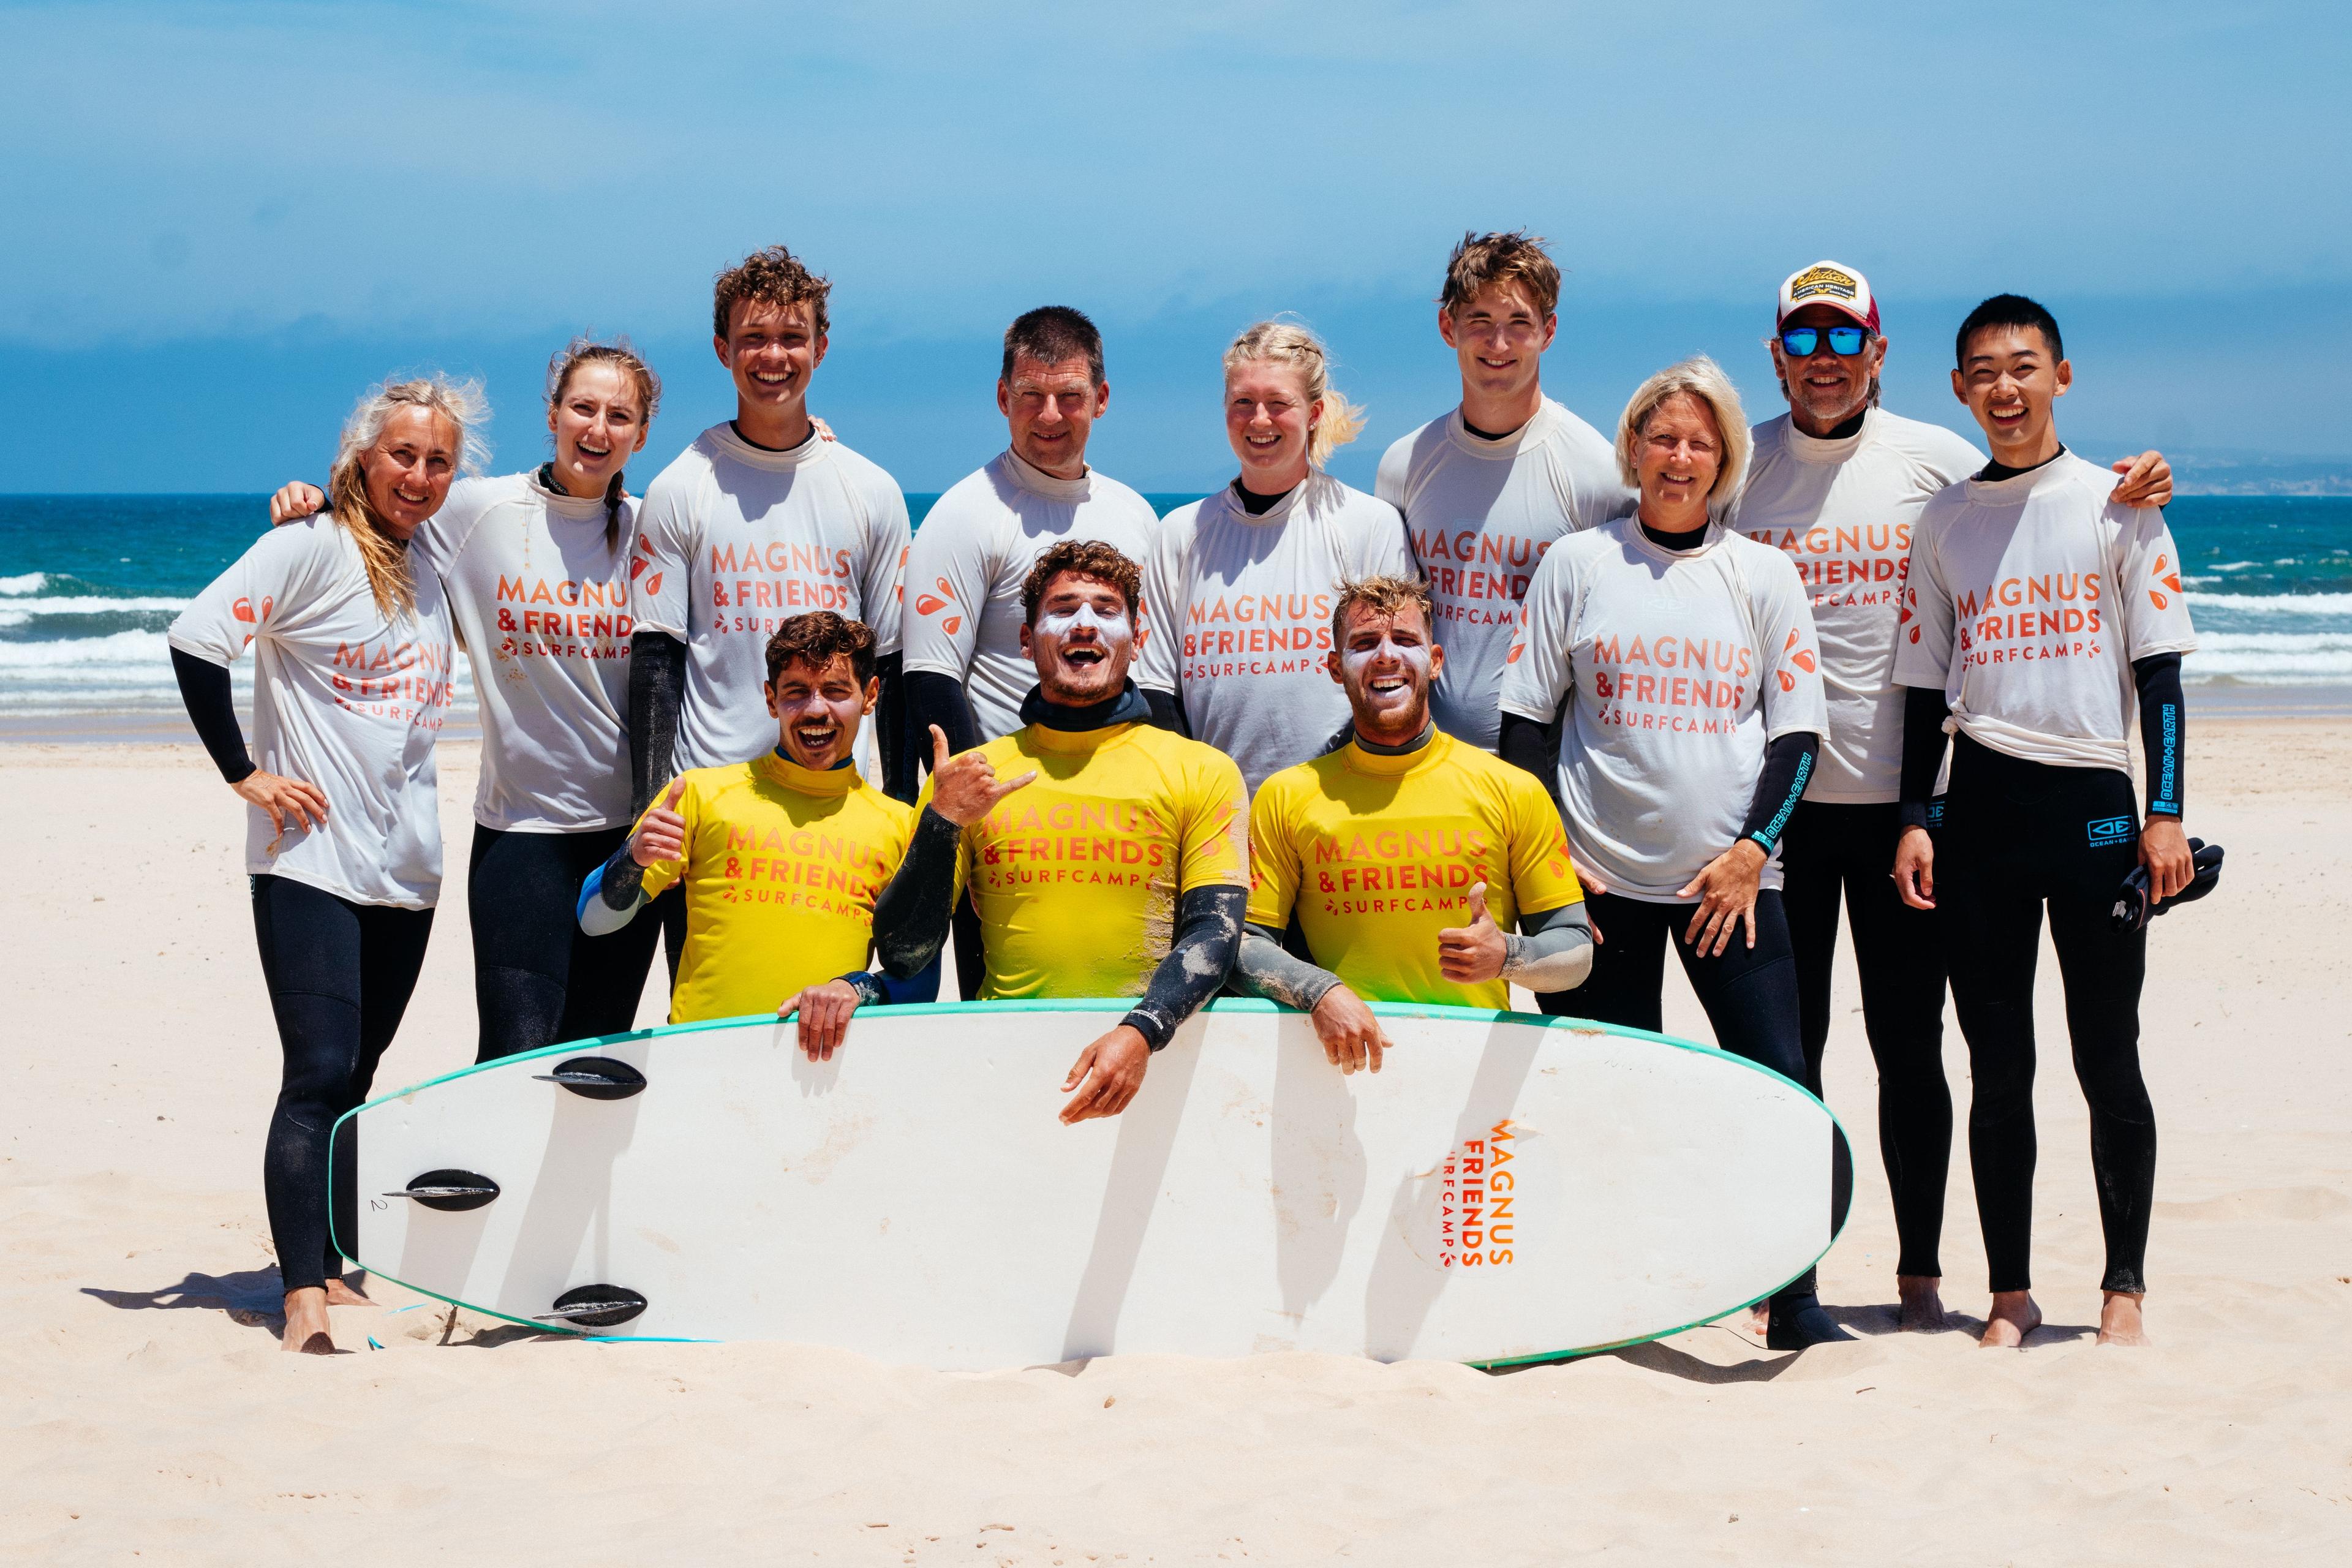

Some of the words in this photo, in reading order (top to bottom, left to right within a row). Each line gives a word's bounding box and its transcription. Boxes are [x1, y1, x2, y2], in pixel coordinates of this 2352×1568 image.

[1793, 284, 1823, 296] AMERICAN
[1825, 284, 1854, 295] HERITAGE
[1794, 266, 1855, 287] Stetson
[712, 541, 851, 578] MAGNUS
[1412, 529, 1553, 569] MAGNUS
[1428, 565, 1531, 600] FRIEND
[1795, 557, 1909, 585] RIENDS
[497, 574, 627, 608] MAGNU
[714, 581, 729, 607] &
[736, 581, 848, 610] FRIENDS
[1958, 573, 2100, 621] MAGNUS
[497, 608, 516, 631] &
[524, 611, 632, 638] FRIEND
[1186, 594, 1330, 626] MAGNUS
[524, 643, 630, 659] SURFCAMP
[1184, 635, 1196, 657] &
[1201, 627, 1332, 655] FRIENDS
[1961, 628, 1971, 651] &
[333, 641, 451, 676] MAGNUS
[1197, 658, 1310, 679] SURFCAMP
[1594, 634, 1752, 678] MAGNUS
[333, 674, 353, 690] &
[361, 677, 454, 708] FRIENDS
[1596, 671, 1613, 698] &
[1618, 674, 1744, 710] FRIENDS
[358, 704, 443, 731] SURFCAMP
[982, 803, 1164, 838] MAGNUS
[726, 823, 888, 878] MAGNUS
[984, 846, 1001, 865] &
[1008, 837, 1164, 867] FRIENDS
[1316, 829, 1487, 864] MAGNUS
[725, 857, 743, 880] &
[750, 859, 880, 908] FRIENDS
[1006, 870, 1140, 887] SURFCAMP
[1319, 871, 1336, 893] &
[1342, 864, 1488, 892] FRIENDS
[744, 889, 861, 921] SURFCAMP
[1343, 896, 1468, 913] SURFCAMP
[1462, 1140, 1484, 1267] FRIENDS
[1490, 1120, 1515, 1265] MAGNUS
